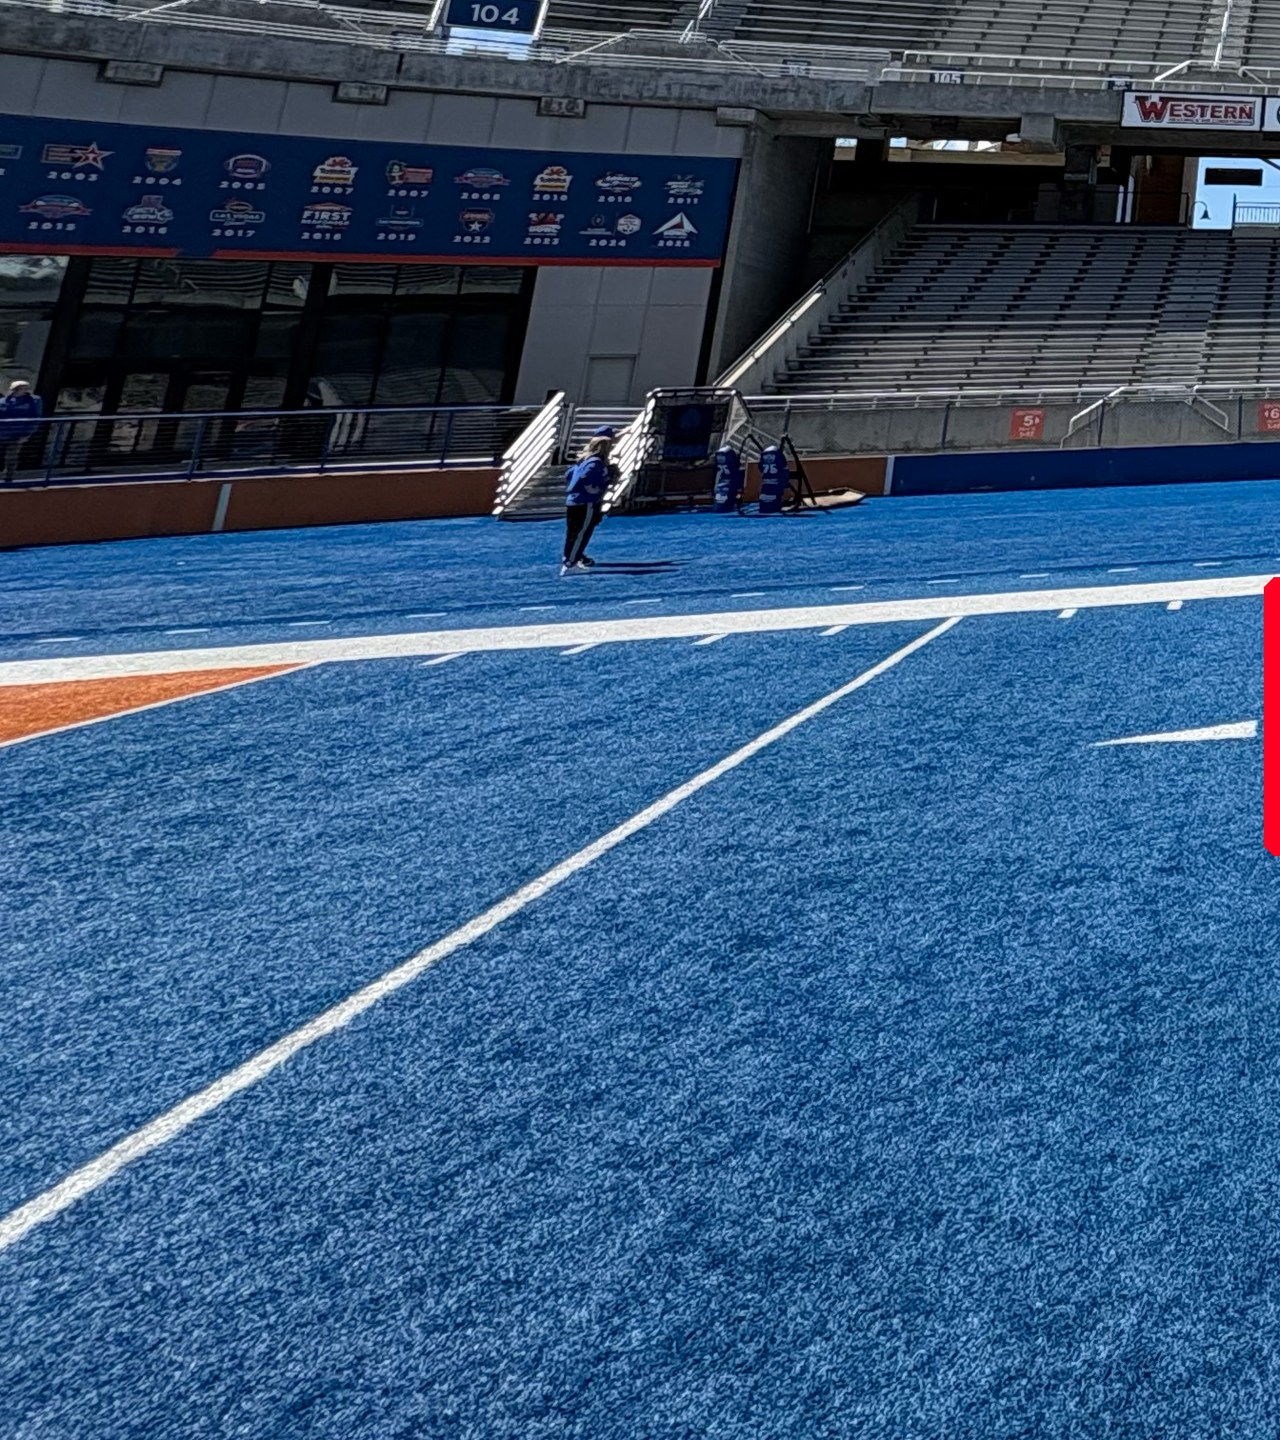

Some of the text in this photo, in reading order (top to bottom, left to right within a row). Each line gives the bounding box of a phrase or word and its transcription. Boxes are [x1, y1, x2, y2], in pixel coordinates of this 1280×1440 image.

[471, 3, 520, 25] 104
[933, 71, 961, 85] 105
[1134, 95, 1254, 123] WESTERN
[47, 170, 99, 182] 2003
[132, 175, 182, 186] 2004
[310, 185, 354, 195] 2007
[387, 188, 429, 198] 2007
[532, 193, 568, 201] 2010
[122, 225, 168, 235] 2016
[211, 228, 256, 238] 2017
[377, 232, 416, 242] 2019
[451, 235, 491, 244] 2022
[523, 237, 560, 245] 2023
[588, 239, 627, 247] 2024
[1270, 408, 1280, 419] 6
[1023, 415, 1034, 427] 5
